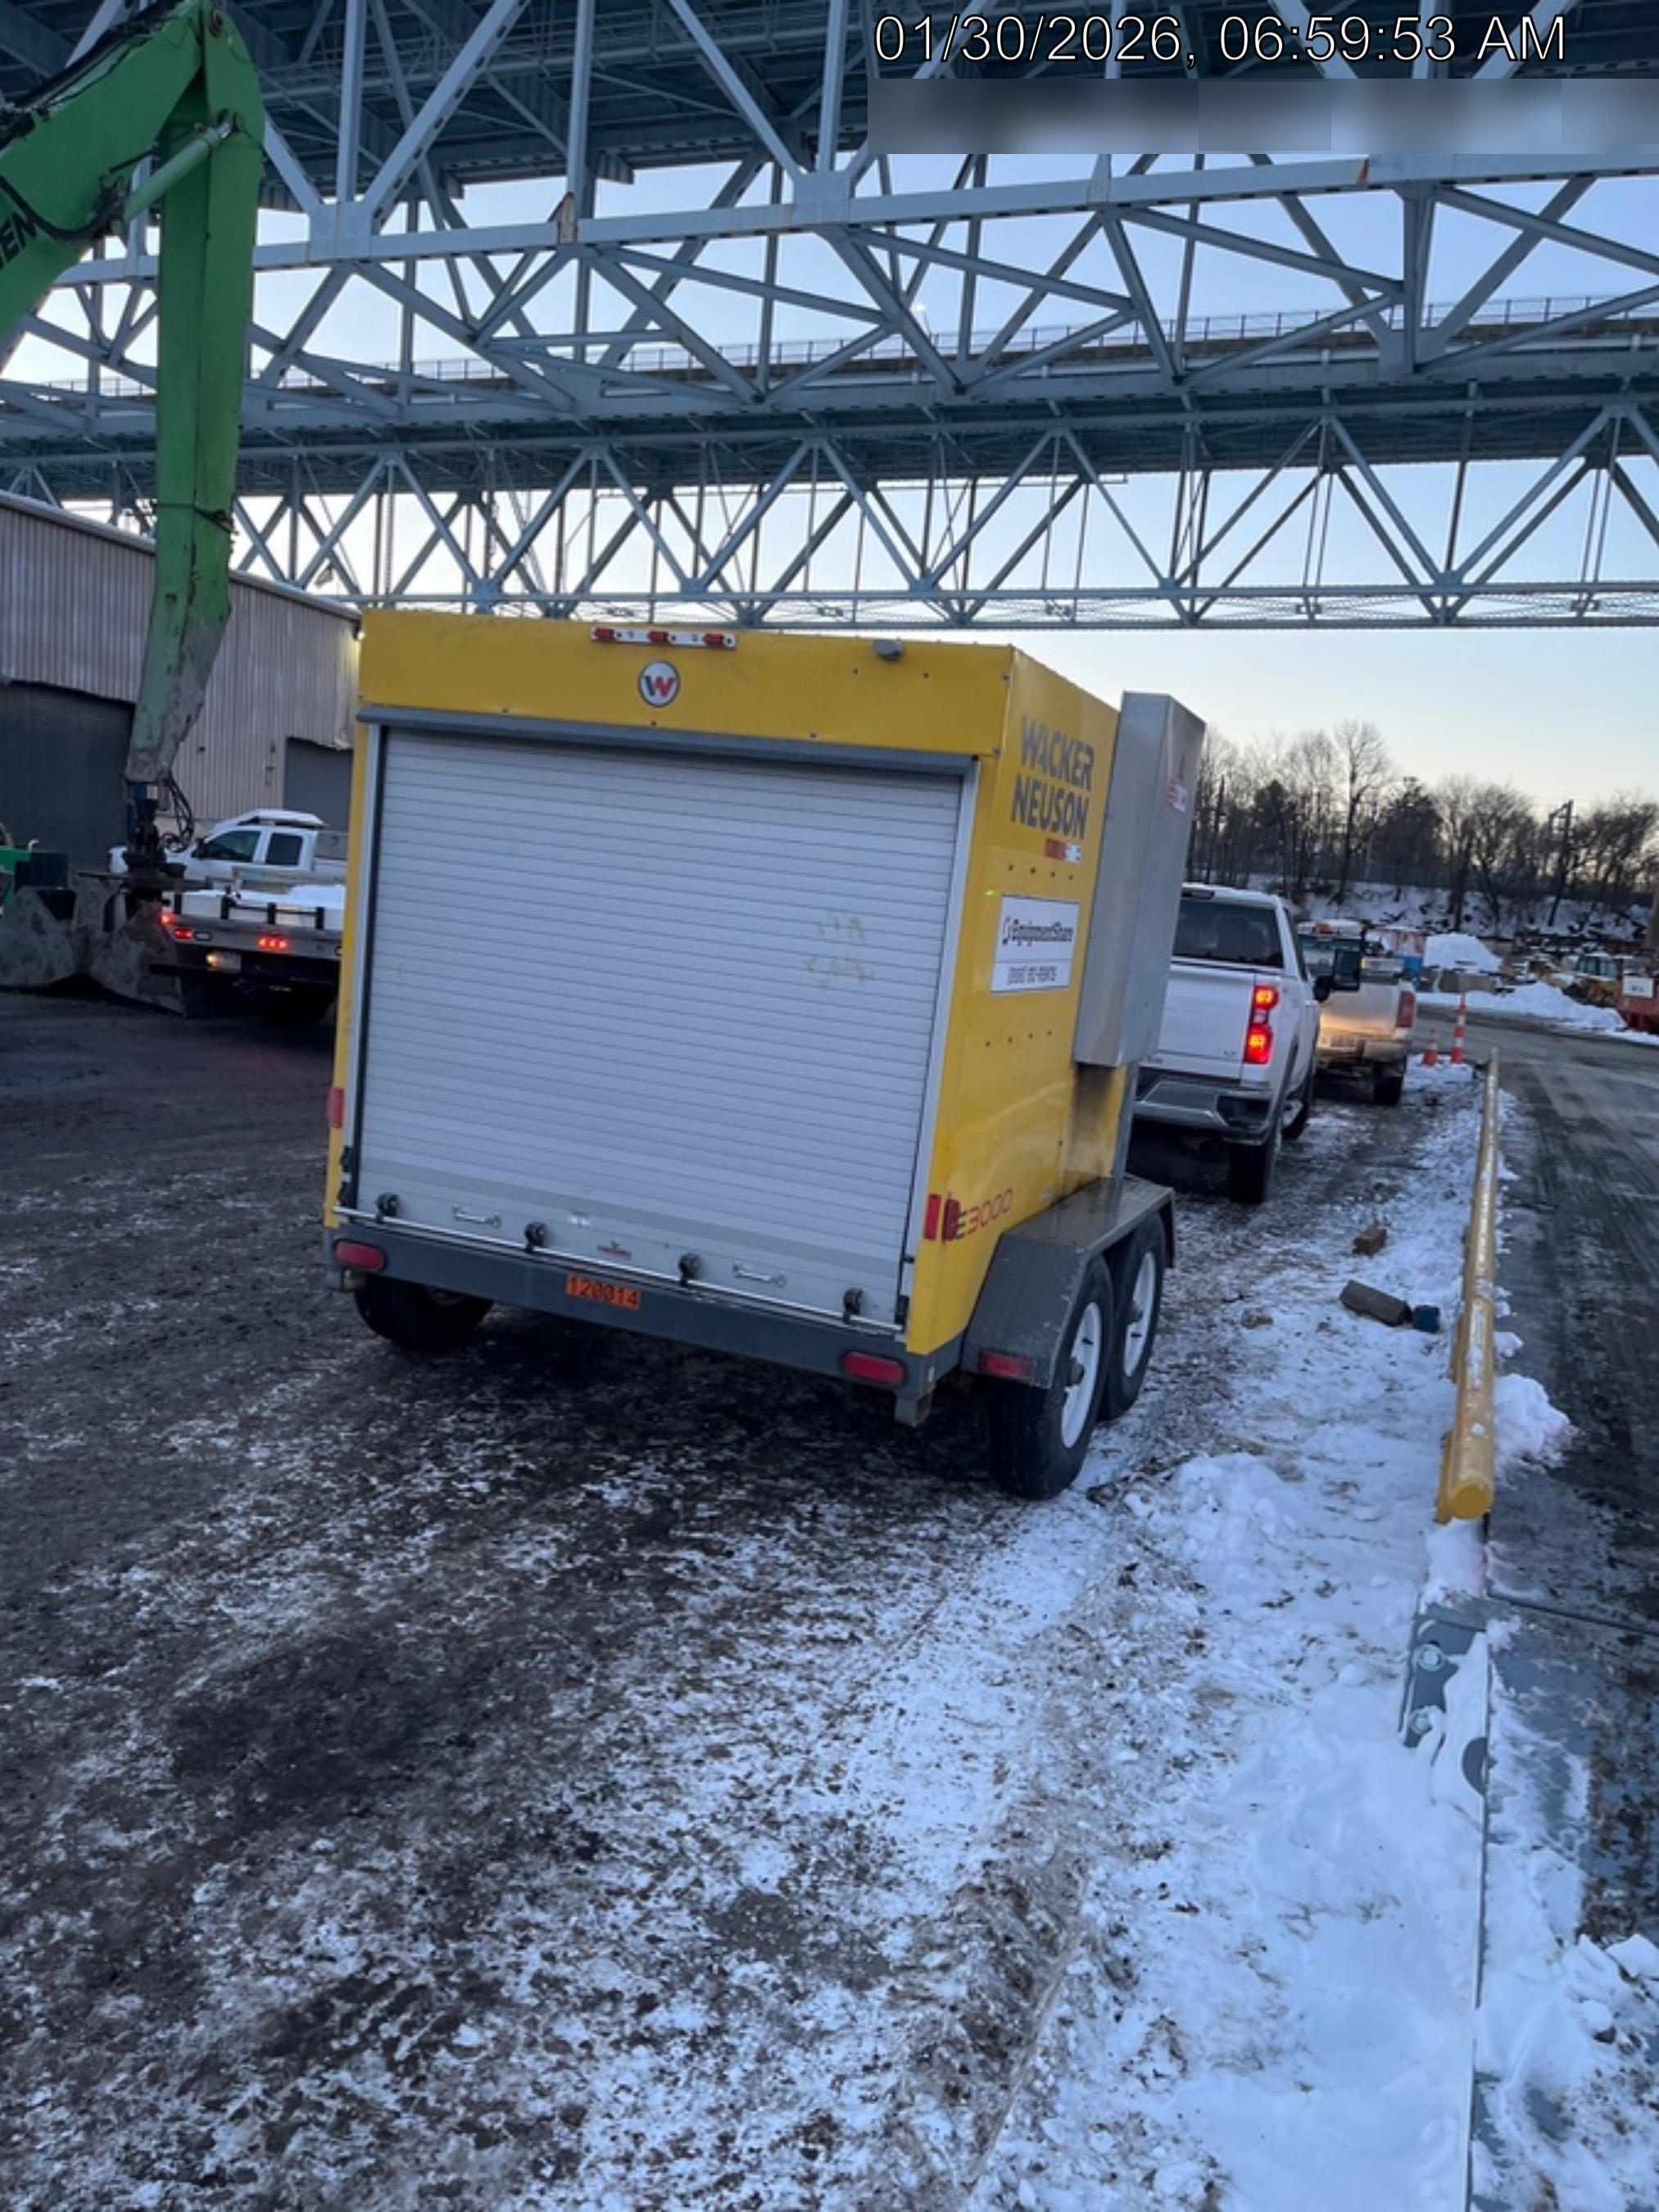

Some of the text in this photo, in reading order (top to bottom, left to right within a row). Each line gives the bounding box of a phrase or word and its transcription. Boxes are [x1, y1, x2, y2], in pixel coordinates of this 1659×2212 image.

[0, 211, 37, 271] EN
[1022, 714, 1095, 792] WACKER
[1010, 774, 1090, 839] NEUSON
